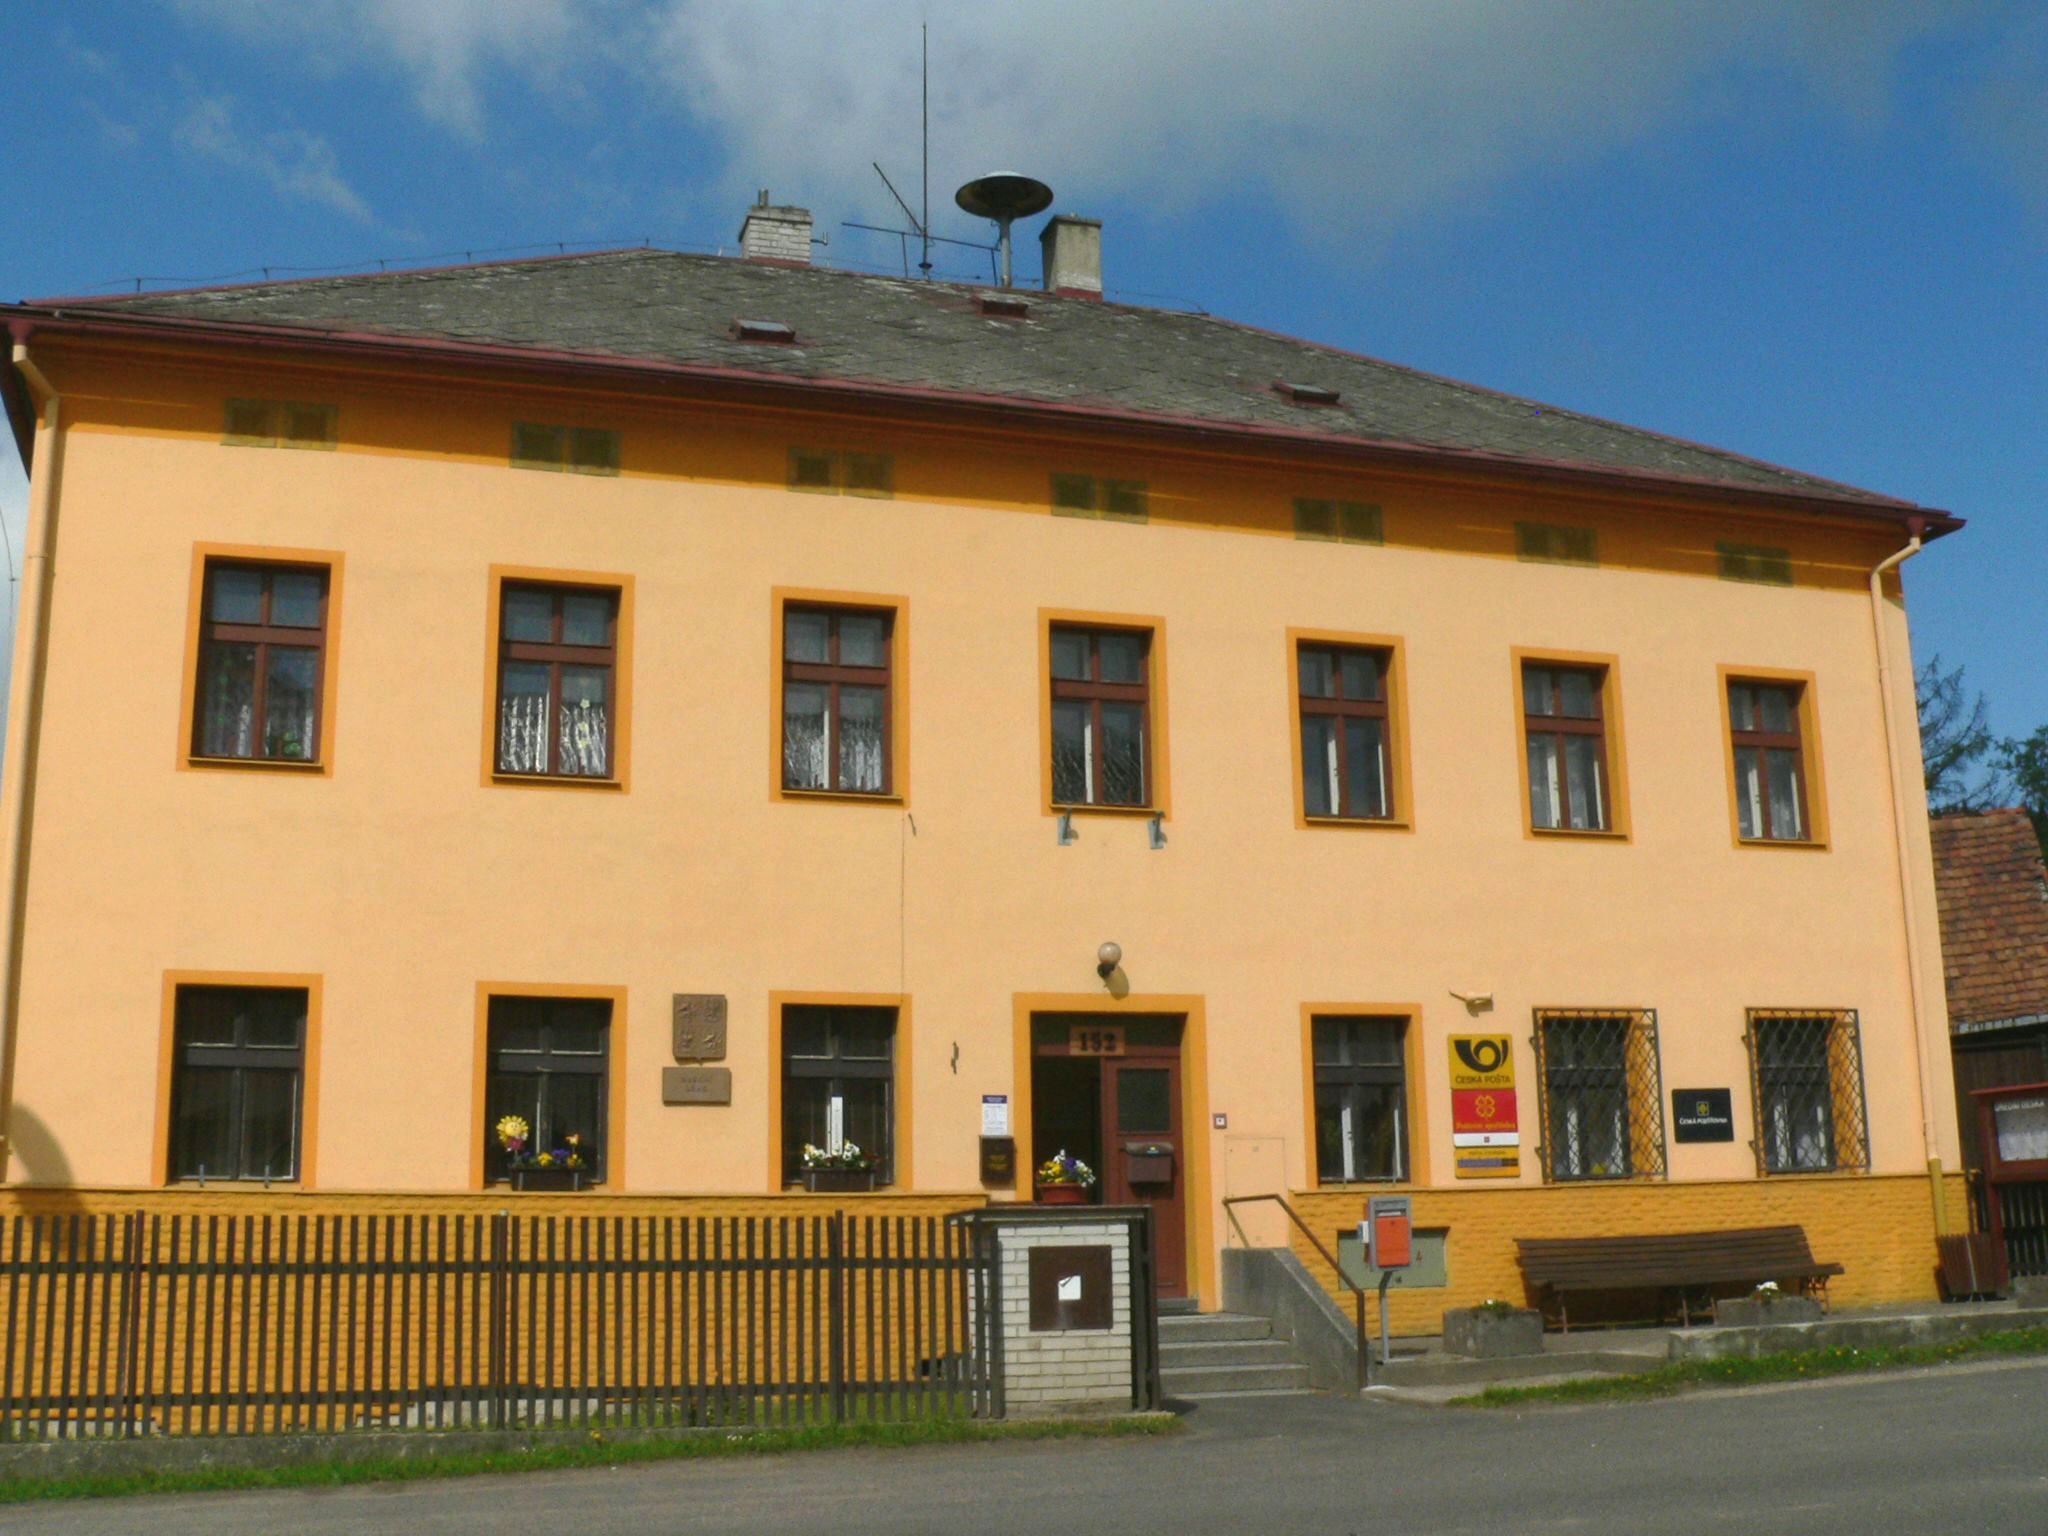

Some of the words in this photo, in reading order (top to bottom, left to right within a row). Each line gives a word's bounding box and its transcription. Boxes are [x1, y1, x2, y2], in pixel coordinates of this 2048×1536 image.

[1080, 1031, 1117, 1052] 152
[1455, 1073, 1482, 1084] ČESKÁ
[1484, 1073, 1511, 1084] POŠTA
